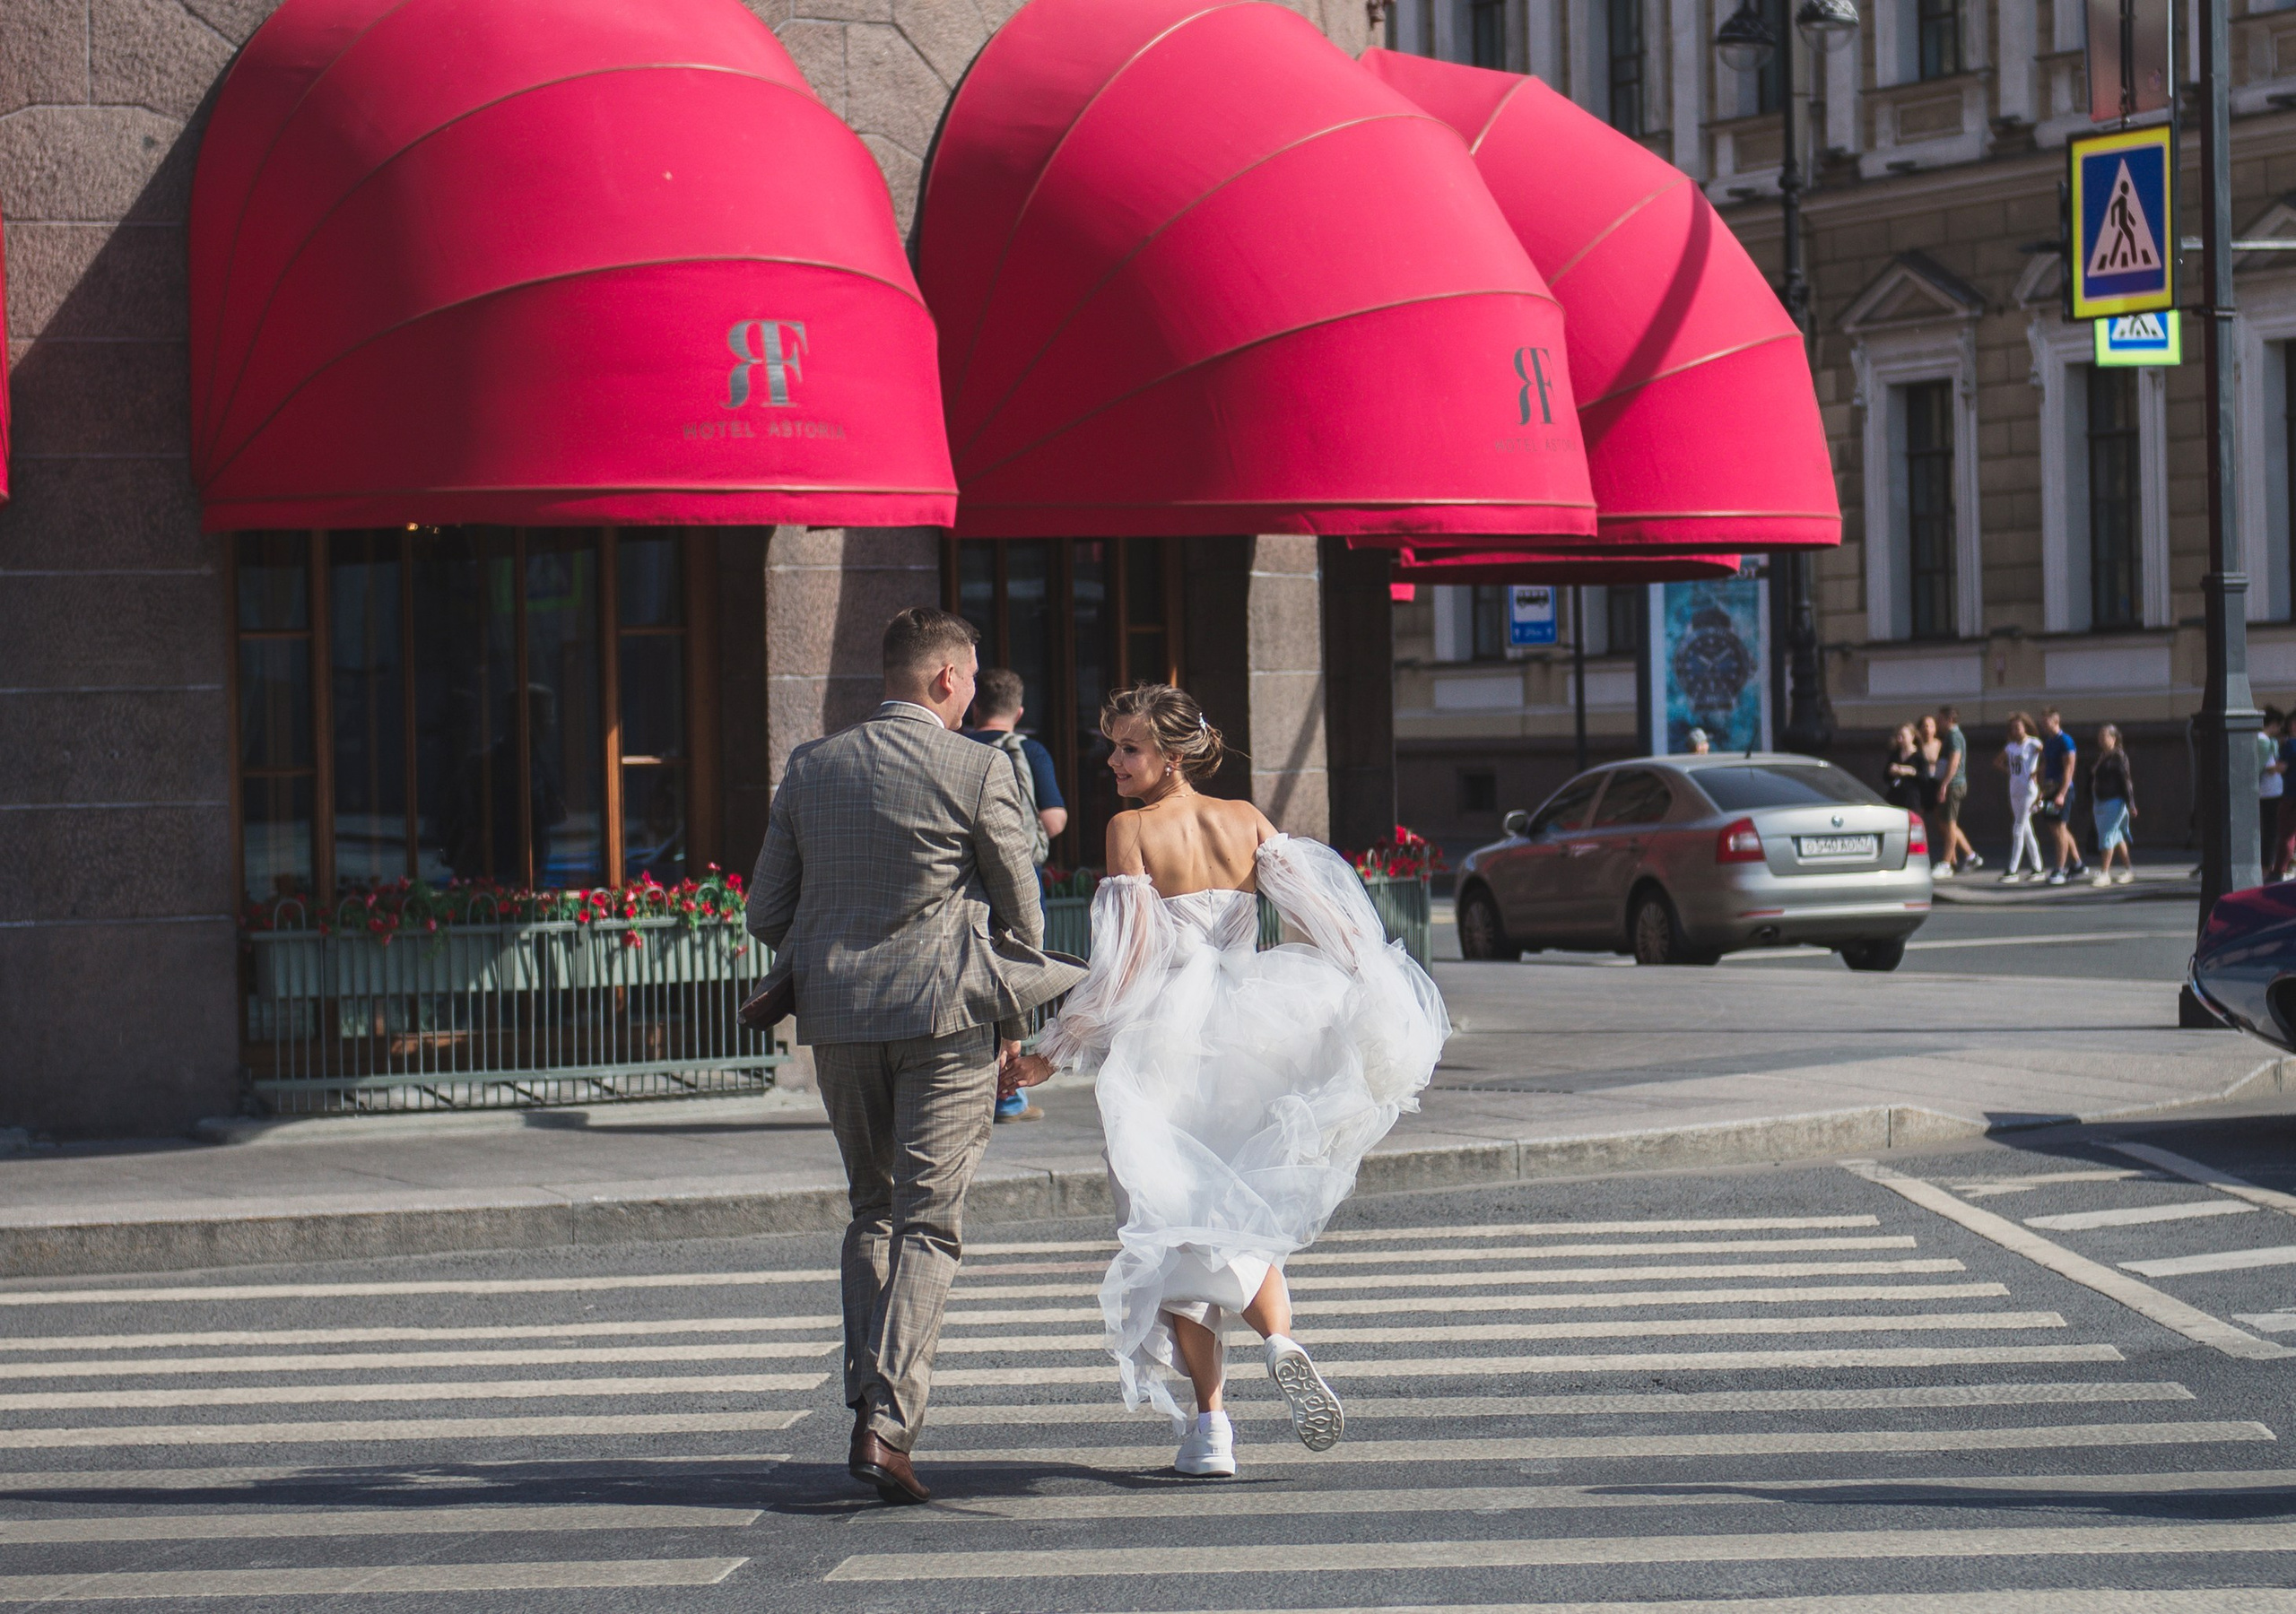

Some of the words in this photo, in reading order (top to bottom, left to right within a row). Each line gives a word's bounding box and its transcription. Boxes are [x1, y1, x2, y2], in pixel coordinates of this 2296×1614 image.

[683, 421, 754, 439] HOTEL
[769, 421, 846, 439] ASTORIA
[1494, 438, 1537, 453] HOTEL
